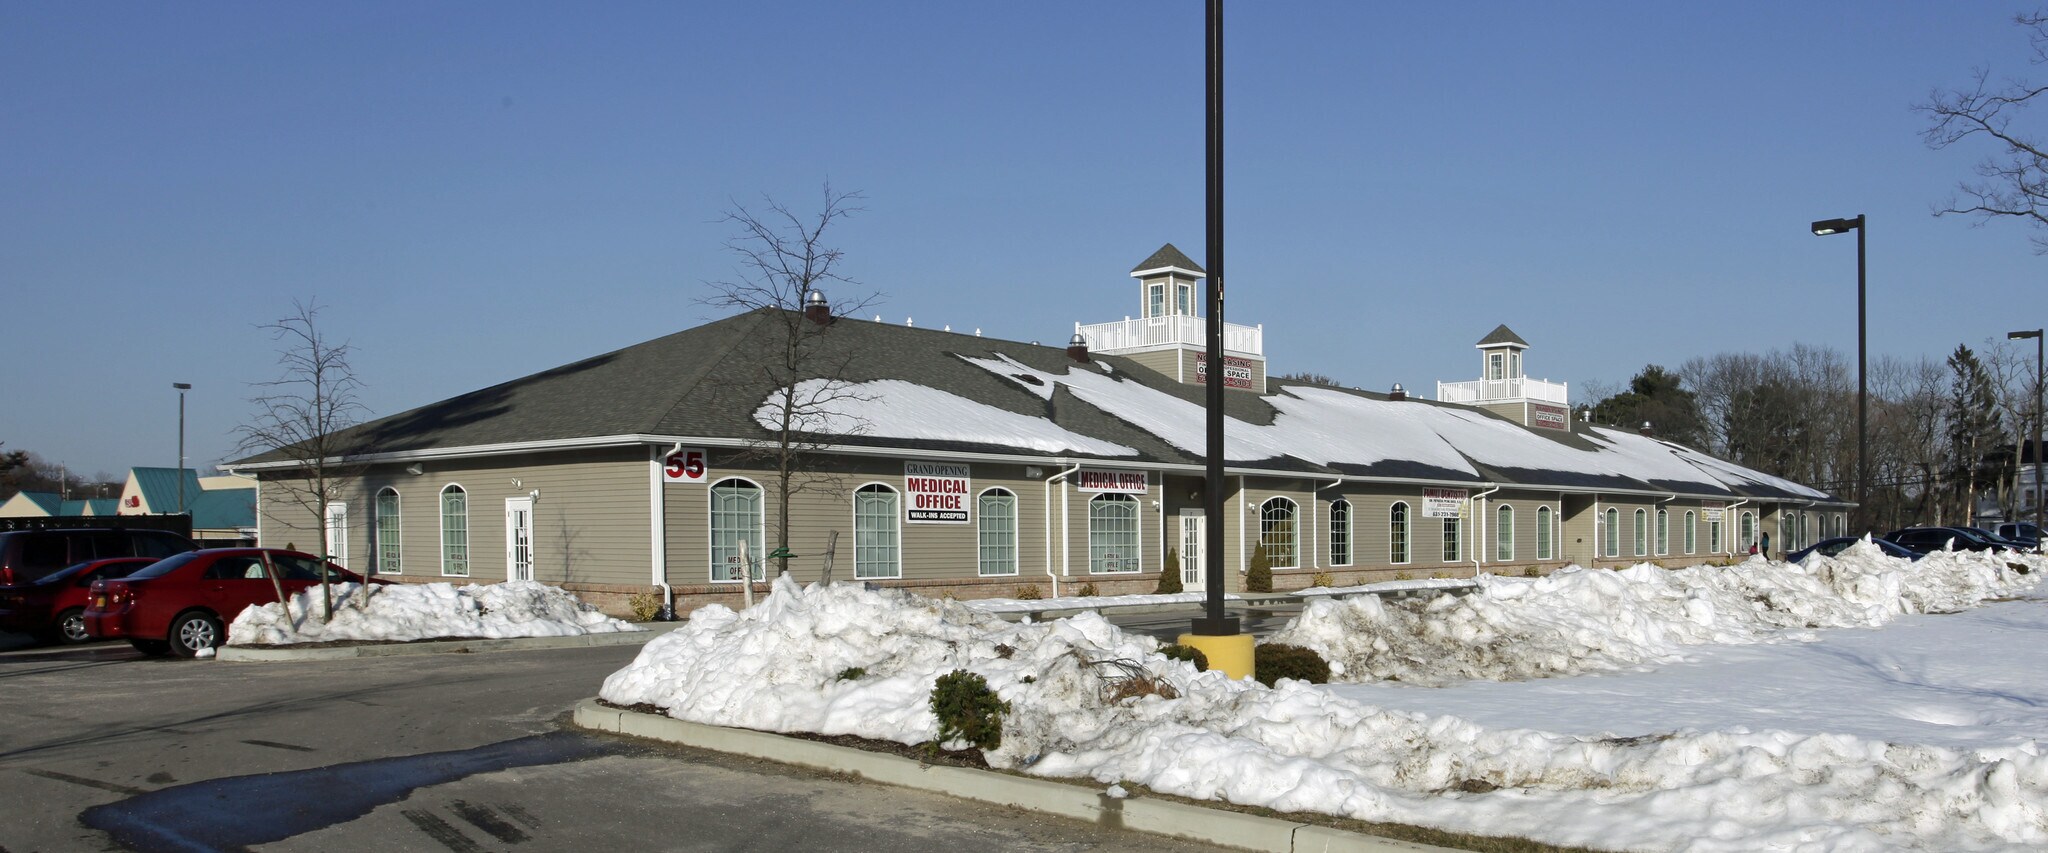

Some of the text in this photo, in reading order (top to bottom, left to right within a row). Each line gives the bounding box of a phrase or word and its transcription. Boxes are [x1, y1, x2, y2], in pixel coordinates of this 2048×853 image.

[1223, 357, 1251, 367] EASING
[1227, 370, 1250, 379] SPACE
[666, 451, 705, 479] 55
[907, 463, 968, 476] GRAND OPENING
[907, 477, 968, 494] MEDICAL
[1081, 471, 1146, 490] MEDICAL OFFICE
[915, 494, 961, 509] OFFICE
[910, 511, 938, 519] WALK-INS
